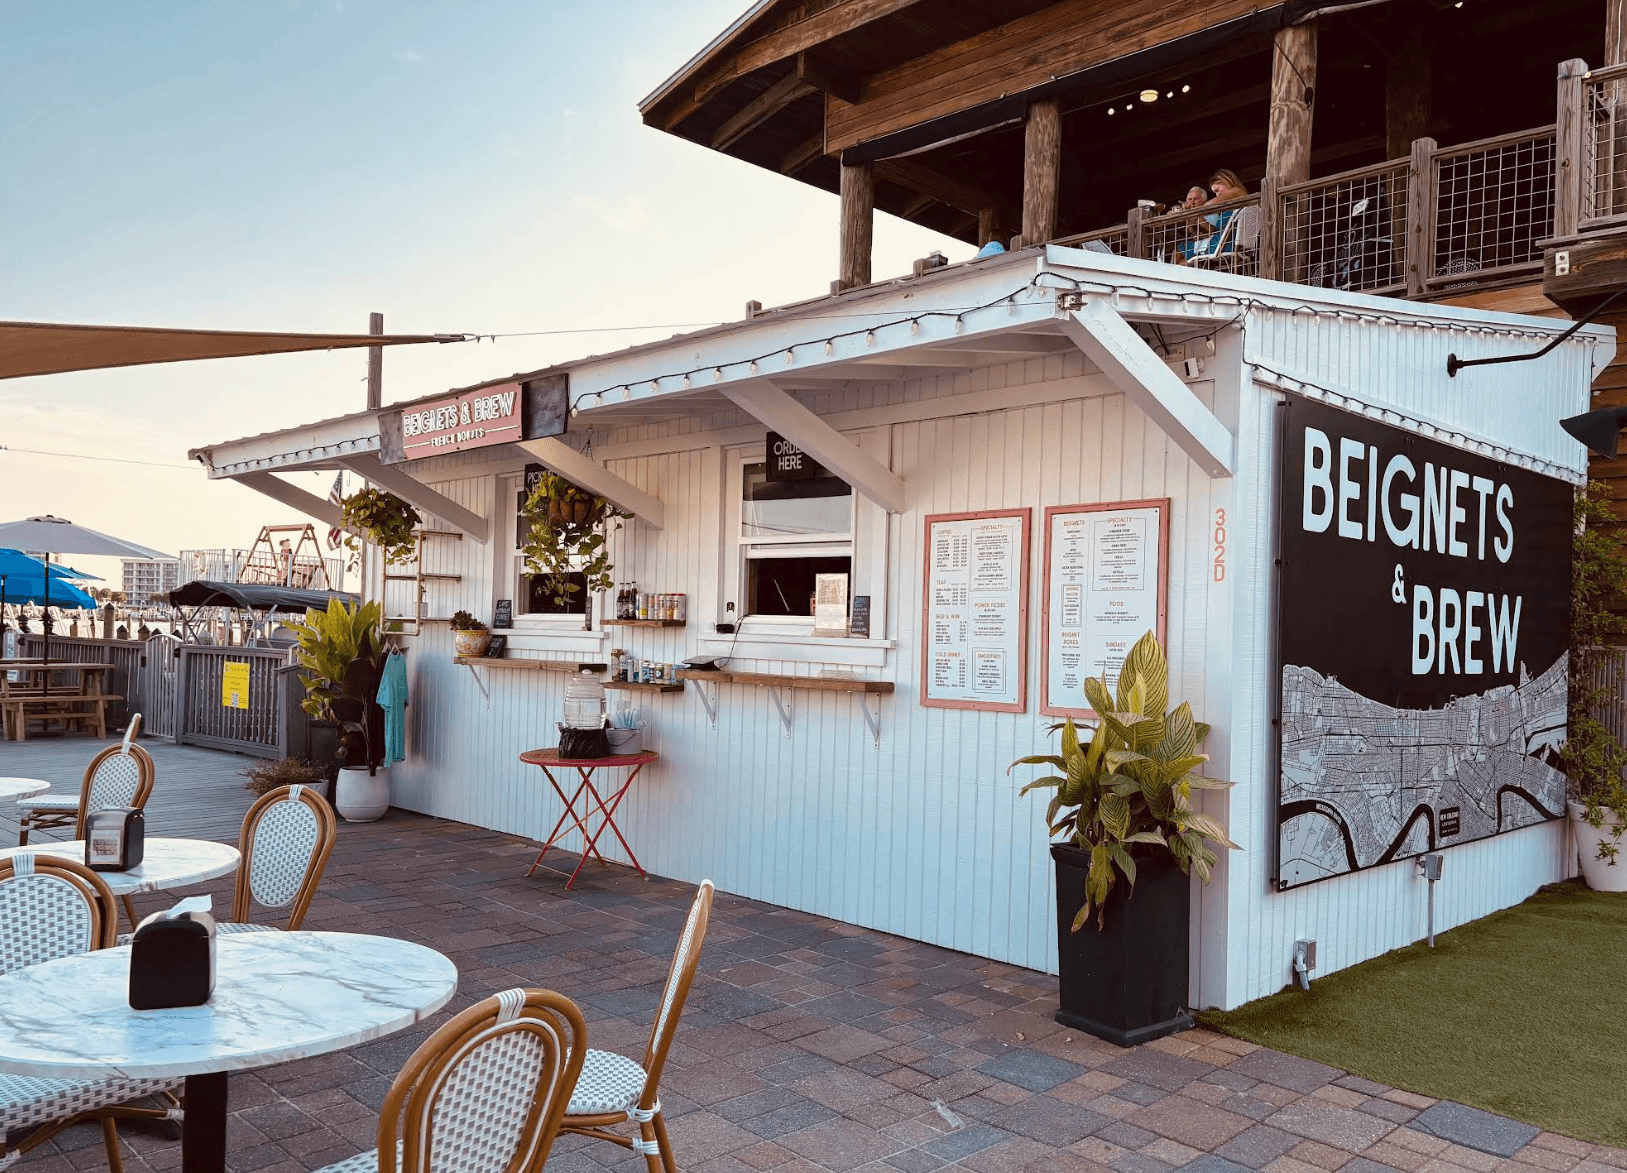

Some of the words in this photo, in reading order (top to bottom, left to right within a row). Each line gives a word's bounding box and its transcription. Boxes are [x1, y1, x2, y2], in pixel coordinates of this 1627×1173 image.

[404, 404, 459, 437] BEIGNETS
[460, 401, 471, 425] &
[474, 391, 517, 423] BREW
[778, 454, 803, 471] HERE
[1303, 426, 1514, 564] BEIGNETS
[1391, 563, 1407, 604] &
[1411, 584, 1522, 675] BREW
